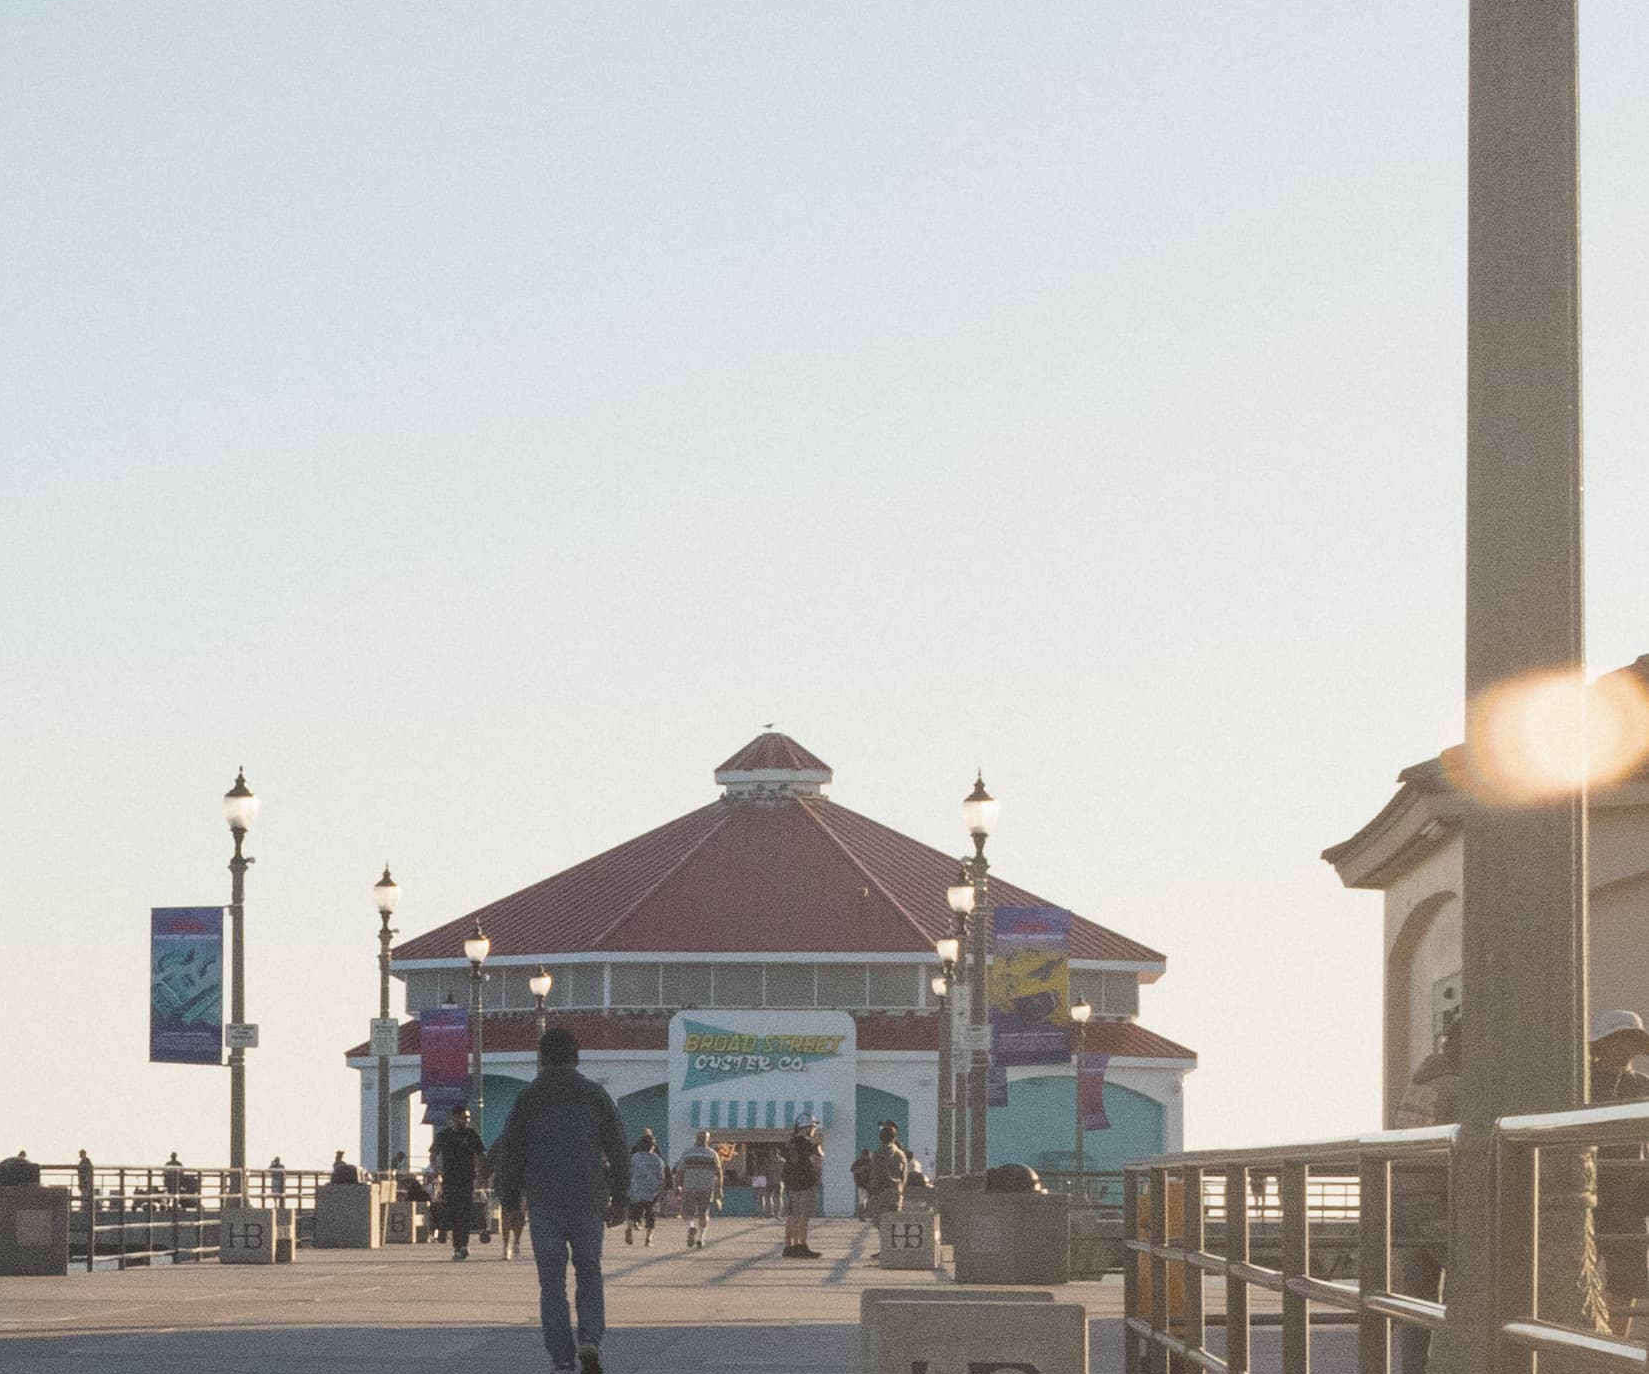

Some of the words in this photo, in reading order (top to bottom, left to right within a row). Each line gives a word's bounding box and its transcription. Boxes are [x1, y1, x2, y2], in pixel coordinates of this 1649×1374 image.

[684, 1033, 758, 1054] BROAD
[763, 1034, 844, 1056] STREET
[229, 1223, 263, 1250] HB
[890, 1223, 923, 1249] HB
